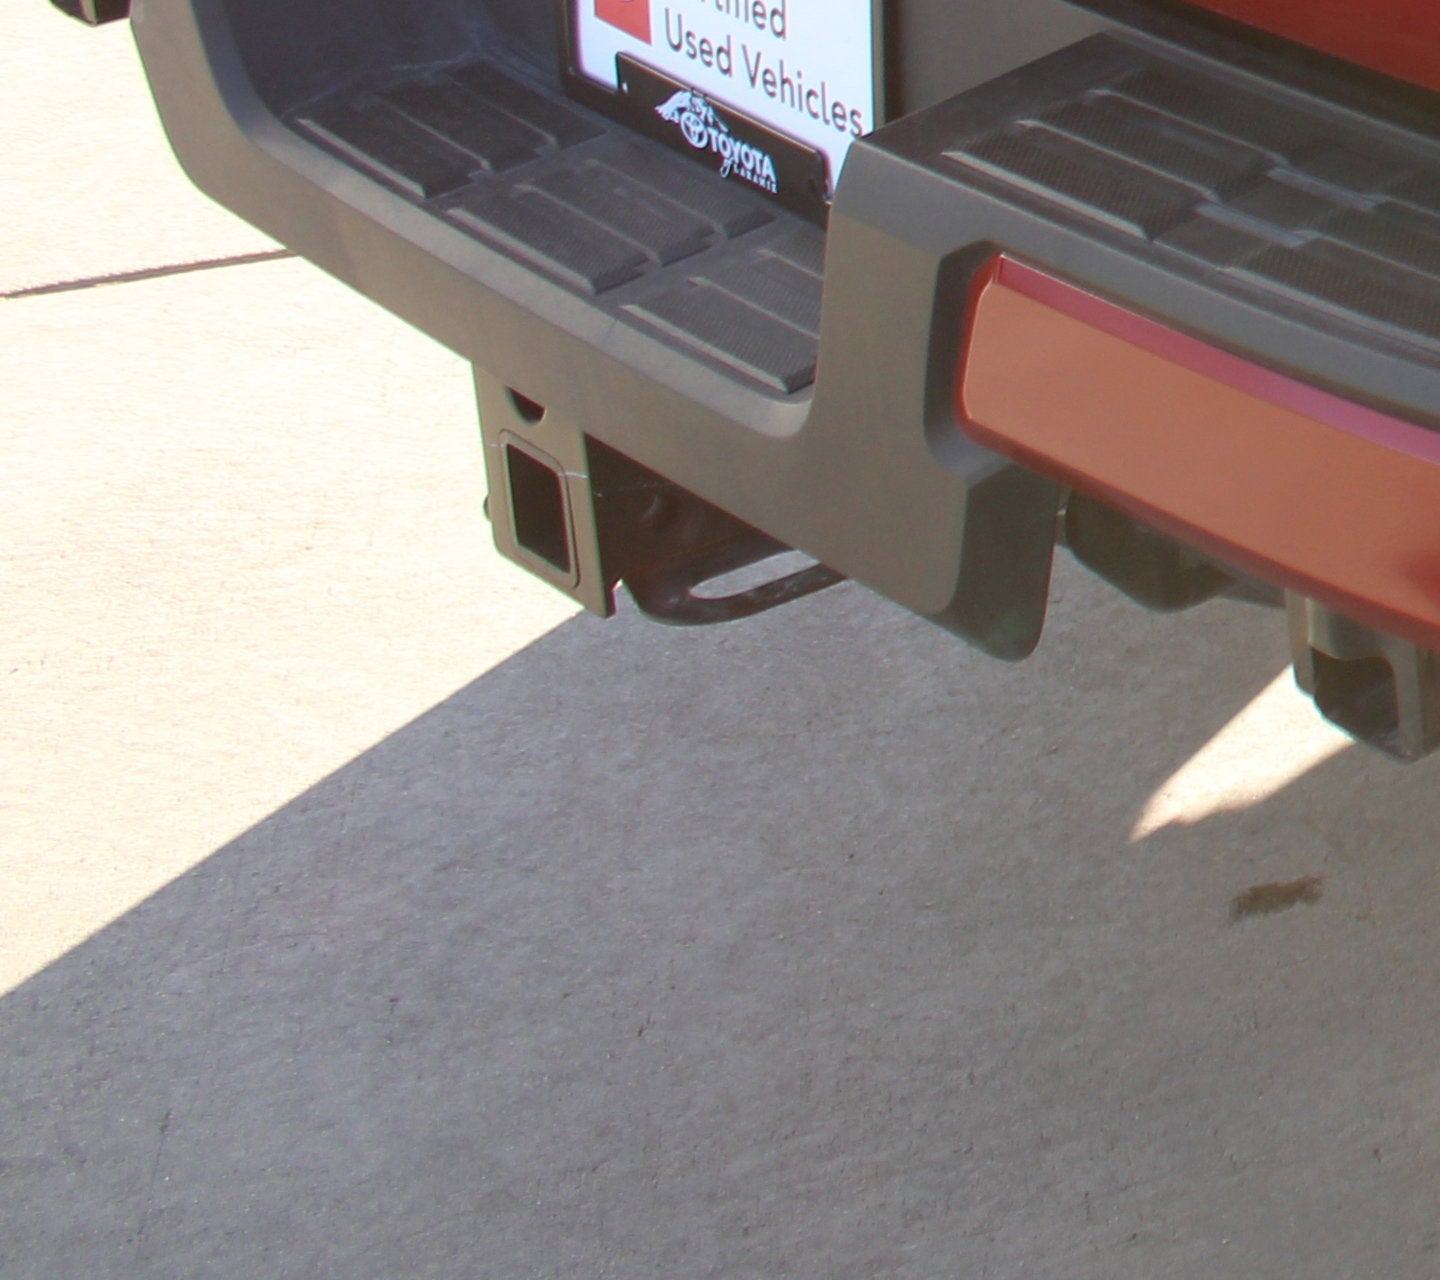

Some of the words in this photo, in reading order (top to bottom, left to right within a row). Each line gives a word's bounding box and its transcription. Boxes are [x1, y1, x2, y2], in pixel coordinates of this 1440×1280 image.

[664, 7, 733, 79] Used
[741, 43, 864, 139] Vehicles
[706, 125, 778, 183] TOYOTA
